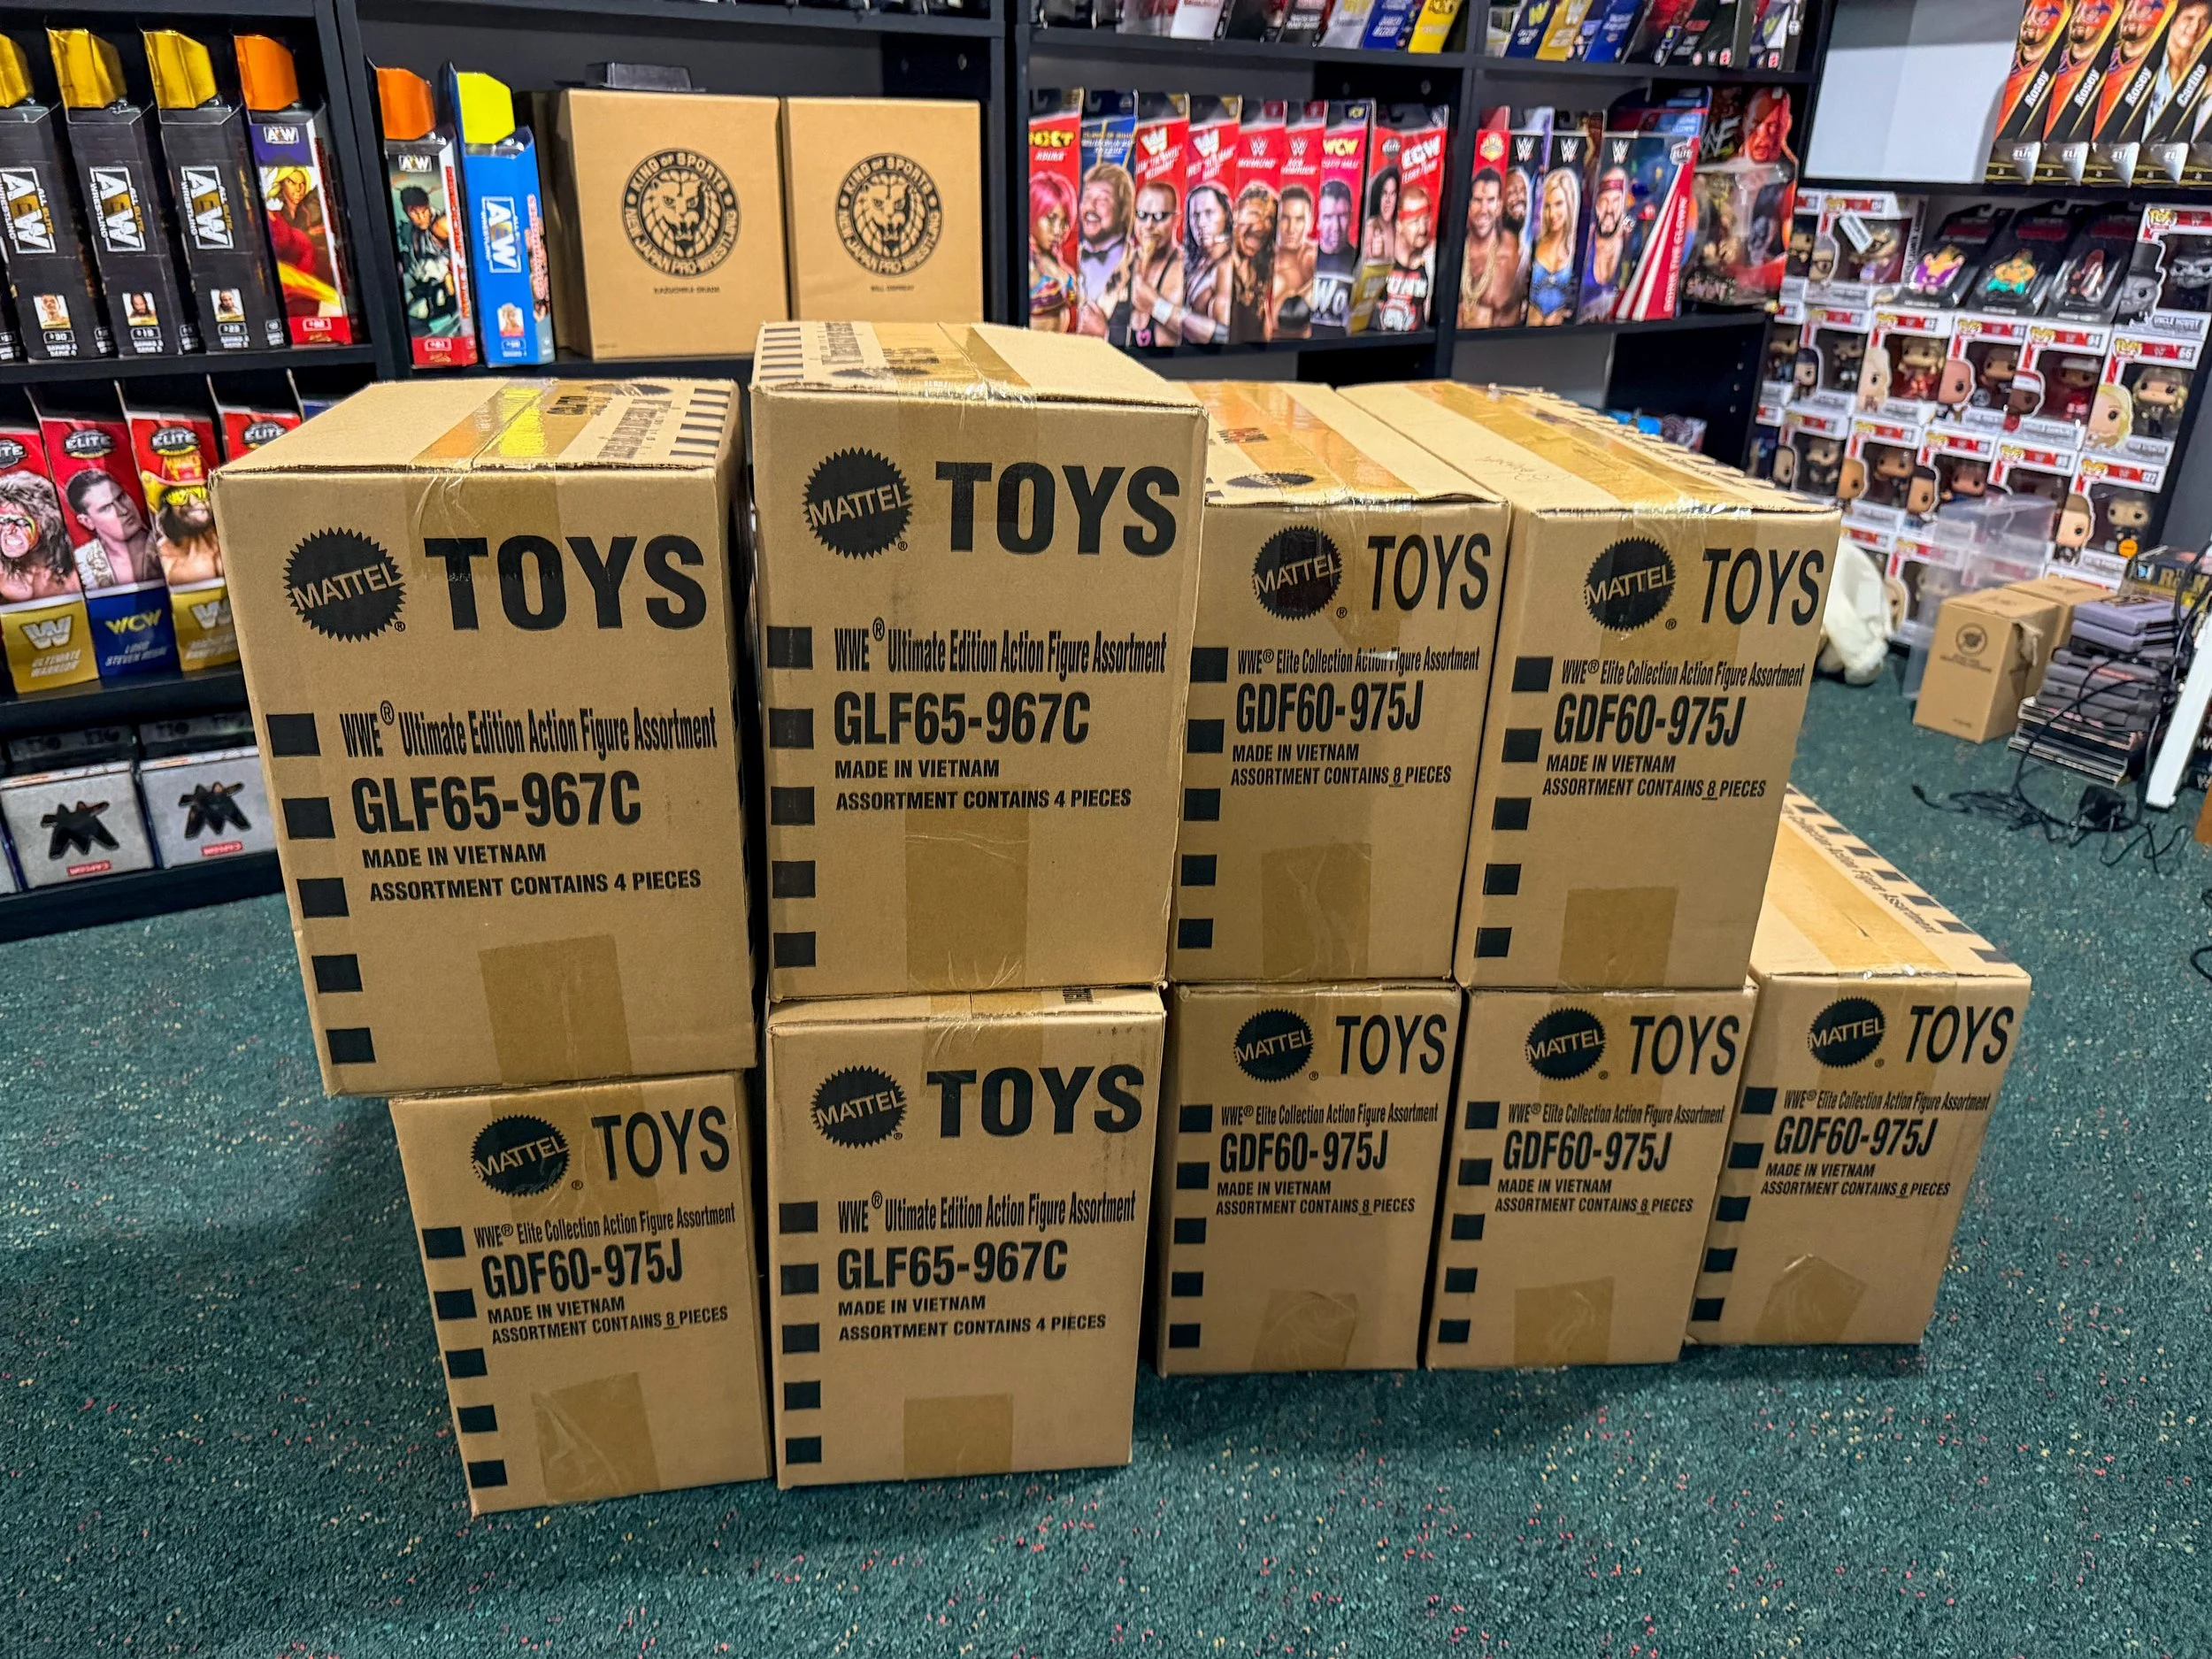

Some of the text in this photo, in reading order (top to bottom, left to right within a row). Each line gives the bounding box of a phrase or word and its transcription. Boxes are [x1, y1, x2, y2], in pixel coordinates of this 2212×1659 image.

[2024, 70, 2050, 109] Rosey
[2073, 69, 2100, 108] Rosey
[2124, 67, 2152, 107] Rosey
[2177, 63, 2207, 108] Carlito
[1323, 139, 1358, 156] WCW
[630, 157, 660, 192] KING
[676, 152, 728, 192] SPORTS
[843, 162, 872, 194] KING
[886, 157, 933, 194] SPORTS
[2, 173, 50, 248] AEW
[90, 182, 108, 238] WRESTLING
[96, 172, 141, 247] AEW
[181, 181, 197, 235] WRESTLING
[187, 171, 228, 245] AEW
[487, 202, 517, 269] AEW
[625, 207, 737, 274] NEW JAPAN PRO WRESTLING
[846, 237, 878, 272] JAPAN
[902, 211, 940, 271] WRESTLING
[65, 436, 111, 449] ELITE
[151, 433, 196, 446] ELITE
[935, 460, 1180, 557] TOYS
[424, 534, 707, 631] TOYS
[1367, 533, 1491, 611] TOYS
[1701, 548, 1824, 626] TOYS
[105, 610, 161, 634] WCW
[887, 629, 945, 672] Ultimate
[949, 630, 996, 672] Edition
[1000, 629, 1045, 672] Action
[1048, 630, 1089, 681] Figure
[1092, 631, 1166, 673] Assortment
[1277, 649, 1300, 674] Elite
[1302, 648, 1353, 673] Collection
[1423, 646, 1479, 672] Assortment
[1601, 659, 1624, 685] Elite
[1626, 660, 1678, 686] Collection
[1679, 661, 1712, 687] Action
[1715, 662, 1747, 691] Figure
[1748, 663, 1805, 687] Assortment
[834, 691, 1090, 745] GLF65-967C
[1236, 680, 1424, 733] GDF60-975J
[1554, 693, 1746, 747] GDF60-975J
[398, 710, 467, 757] Ultimate
[470, 710, 525, 754] Edition
[531, 708, 579, 753] Action
[580, 708, 629, 761] Figure
[634, 707, 718, 750] Assortment
[1233, 744, 1359, 762] MADE IN VIETNAM
[1231, 765, 1451, 787] ASSORTMENT CONTAINS 8 PIECES
[1542, 778, 1767, 798] ASSORTMENT CONTAINS 8 PIECES
[351, 770, 641, 833] GLF65-967C
[362, 843, 546, 868] MADE IN VIETNAM
[370, 869, 701, 902] ASSORTMENT CONTAINS 4 PIECES
[1335, 1014, 1448, 1075] TOYS
[1630, 1015, 1740, 1076] TOYS
[1905, 1004, 2015, 1064] TOYS
[926, 1064, 1144, 1139] TOYS
[1256, 1105, 1277, 1125] Elite
[1279, 1104, 1325, 1125] Collection
[1326, 1104, 1356, 1125] Action
[1357, 1103, 1386, 1127] Figure
[1387, 1102, 1438, 1124] Assortment
[1542, 1103, 1563, 1124] Elite
[1565, 1103, 1611, 1124] Collection
[1612, 1103, 1643, 1125] Action
[1645, 1103, 1673, 1127] Figure
[1673, 1104, 1725, 1125] Assortment
[1816, 1090, 1839, 1110] Elite
[1839, 1090, 1883, 1110] Collection
[1883, 1091, 1913, 1110] Action
[1914, 1091, 1943, 1114] Figure
[1942, 1092, 1991, 1112] Assortment
[591, 1106, 730, 1181] TOYS
[1220, 1129, 1388, 1173] GDF60-975J
[1503, 1130, 1672, 1171] GDF60-975J
[1774, 1116, 1939, 1157] GDF60-975J
[1761, 1181, 1950, 1197] ASSORTMENT CONTAINS 8 PIECES
[1766, 1163, 1876, 1178] MADE IN VIETNAM
[516, 1222, 542, 1245] Elite
[545, 1217, 601, 1242] Collection
[603, 1213, 637, 1237] Action
[640, 1210, 674, 1236] Figure
[676, 1202, 736, 1229] Assortment
[885, 1197, 937, 1233] Ultimate
[941, 1196, 982, 1231] Edition
[986, 1194, 1025, 1227] Action
[1027, 1193, 1066, 1233] Figure
[1069, 1190, 1136, 1225] Assortment
[1216, 1197, 1416, 1216] ASSORTMENT CONTAINS 8 PIECES
[480, 1238, 683, 1300] GDF60-975J
[837, 1239, 1068, 1291] GLF65-967C
[492, 1306, 728, 1346] ASSORTMENT CONTAINS 8 PIECES
